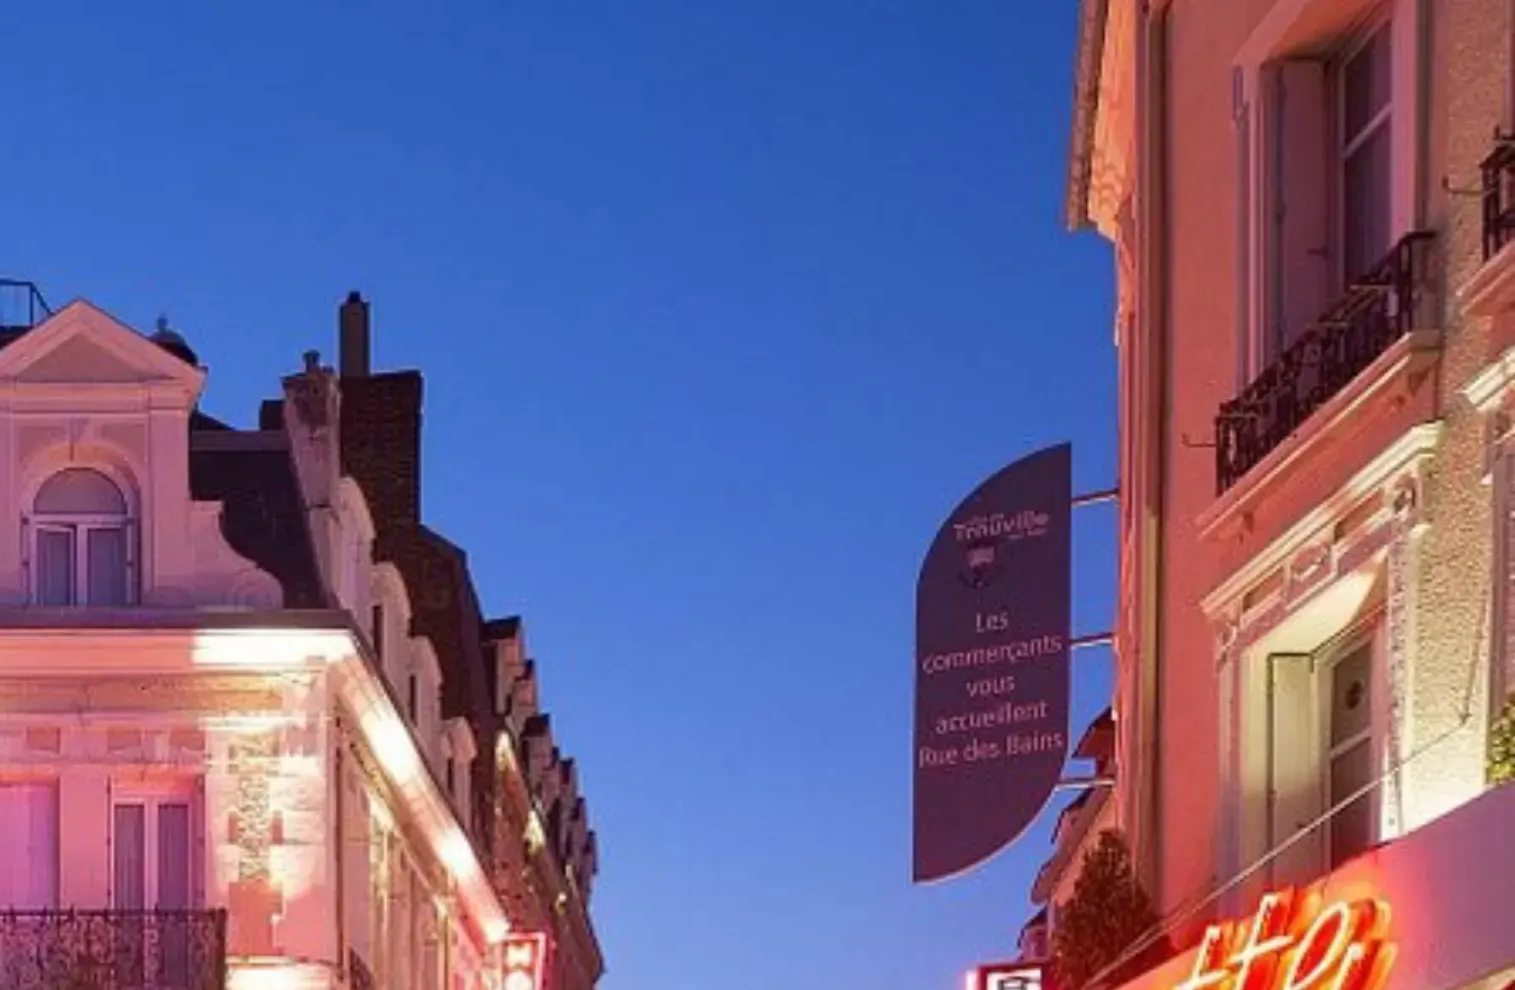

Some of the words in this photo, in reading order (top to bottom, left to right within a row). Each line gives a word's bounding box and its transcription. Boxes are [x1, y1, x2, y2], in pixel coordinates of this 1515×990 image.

[975, 611, 1009, 634] Les
[921, 635, 1063, 675] commerçants
[965, 675, 1016, 698] vous
[935, 700, 1049, 735] accueillent
[918, 746, 959, 769] Rue
[963, 738, 1001, 762] des
[1005, 731, 1065, 755] Bains
